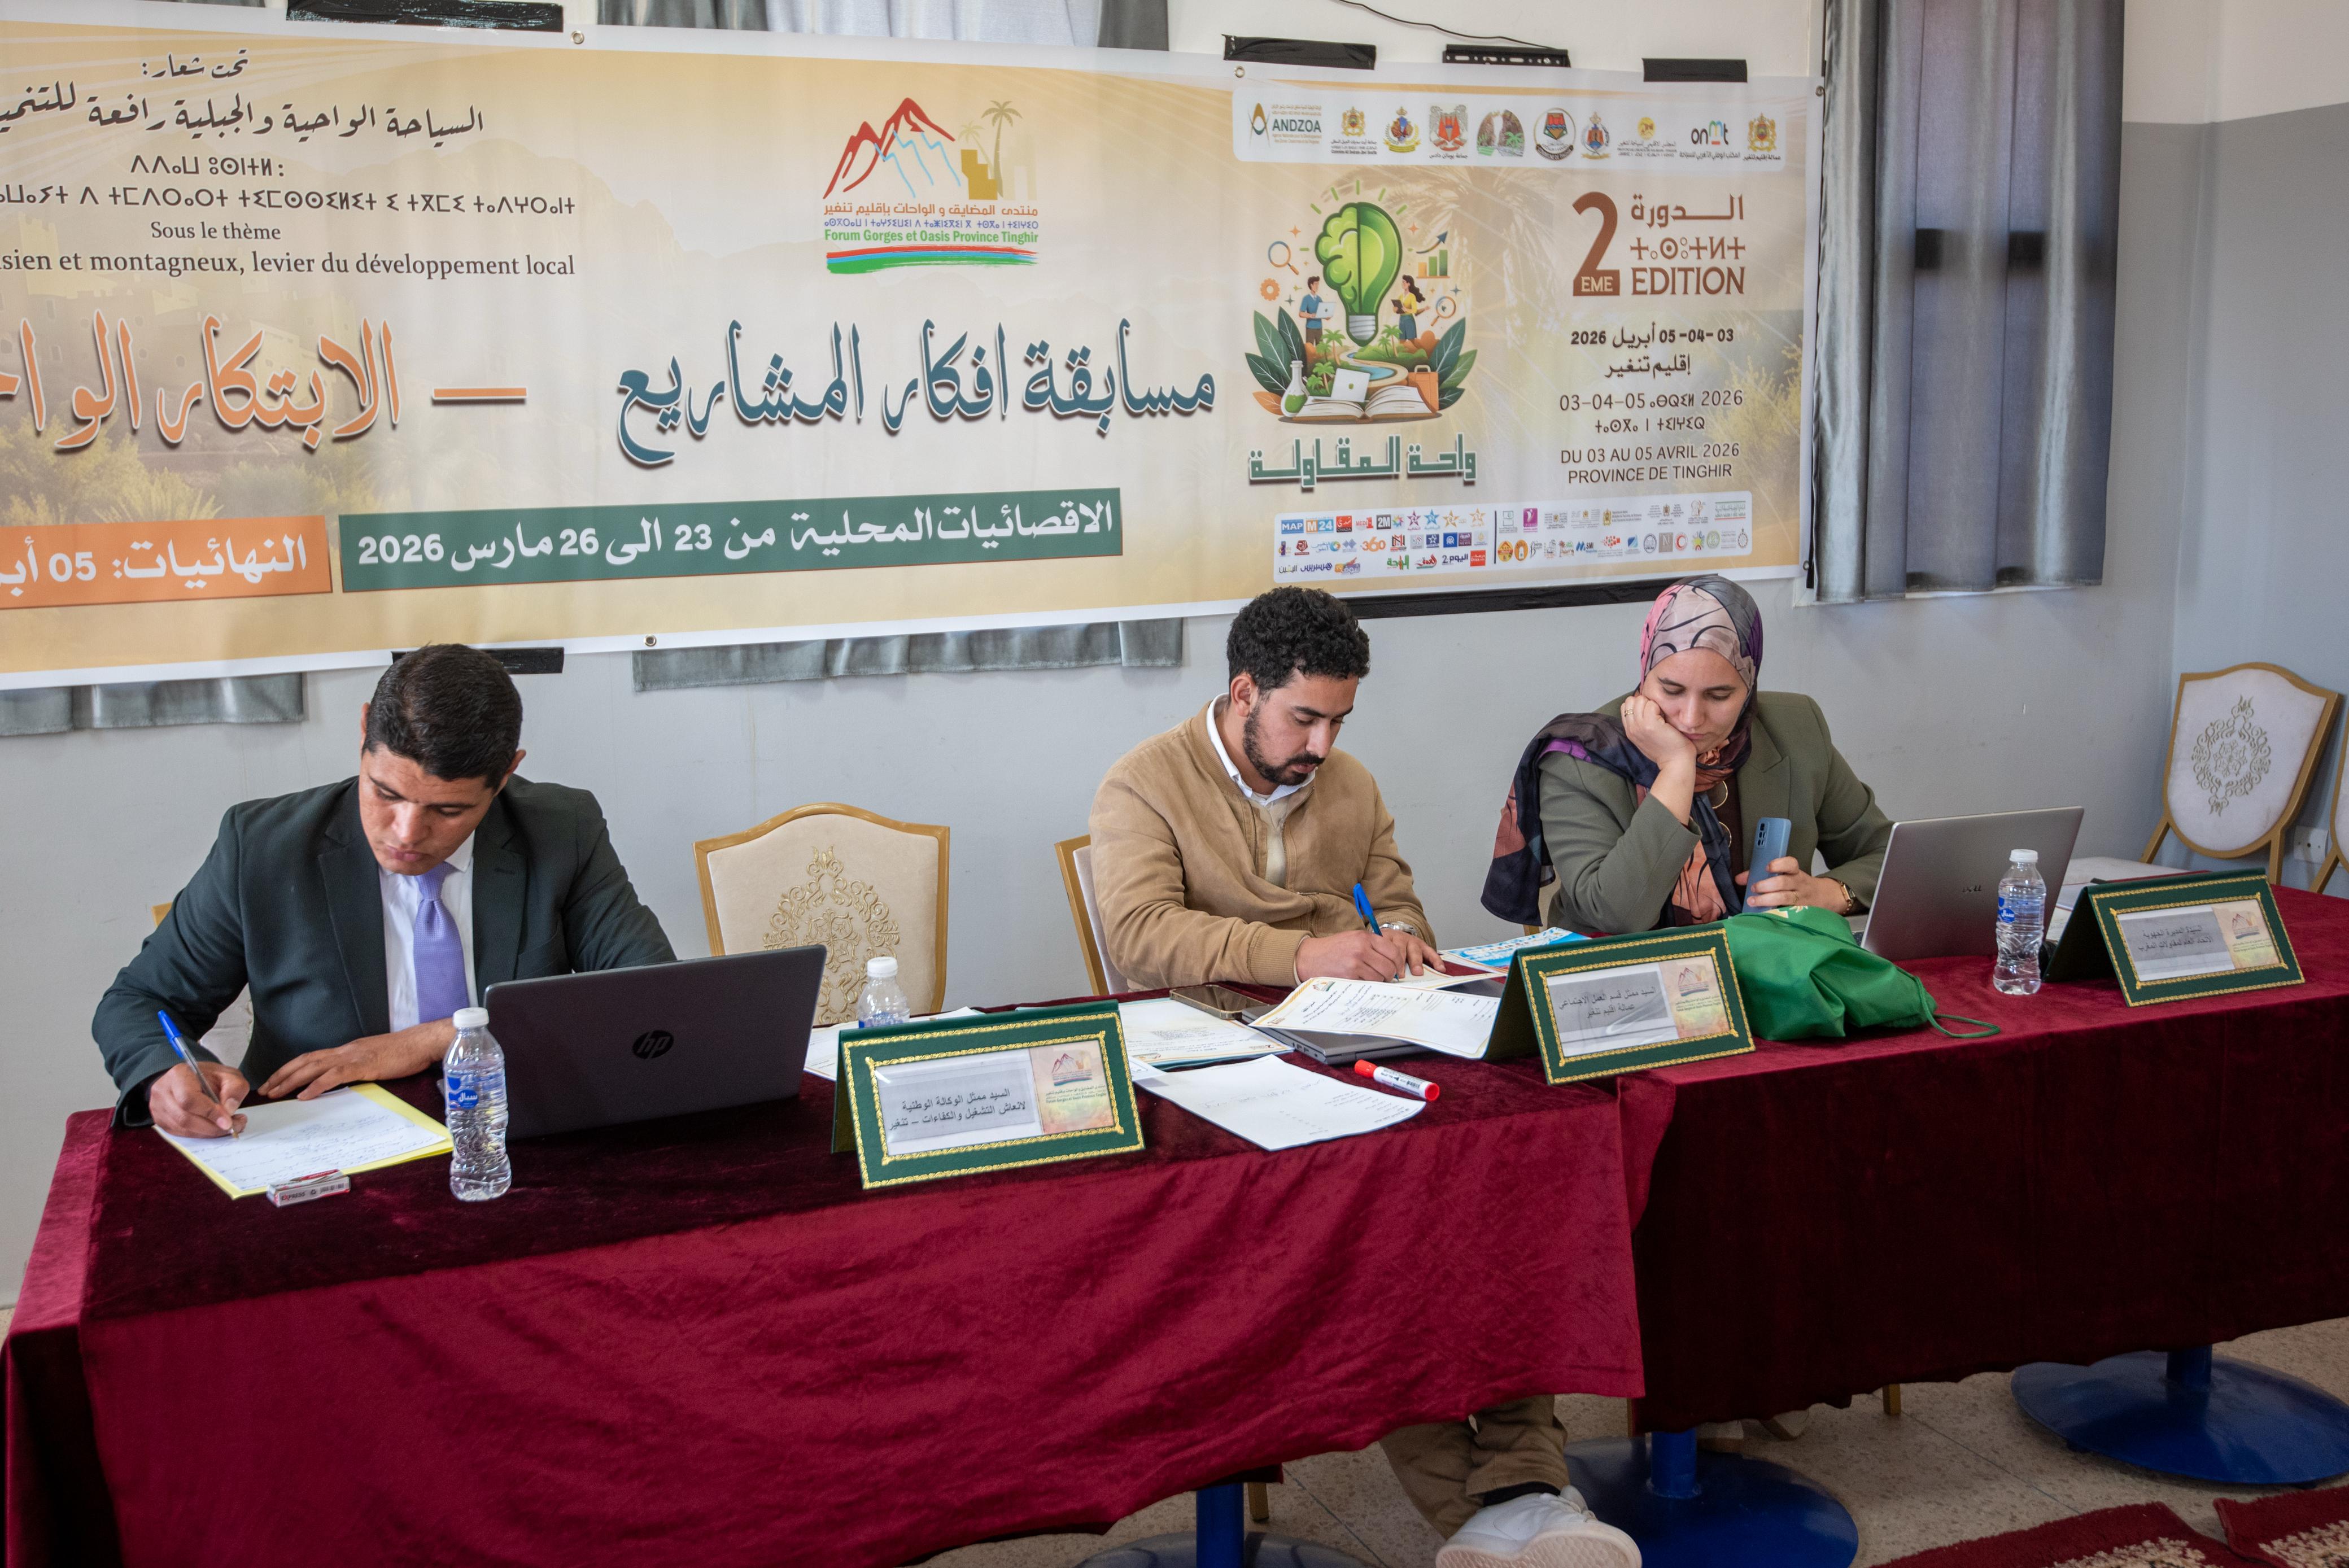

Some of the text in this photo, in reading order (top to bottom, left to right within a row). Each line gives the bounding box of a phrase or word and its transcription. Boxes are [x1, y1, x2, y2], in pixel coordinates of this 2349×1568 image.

[211, 49, 249, 78] تحت
[0, 80, 77, 133] للتنمي
[86, 93, 167, 131] رافعة
[282, 103, 377, 143] الواحية
[386, 103, 484, 148] السياحة
[1272, 119, 1321, 133] ANDZOA
[824, 202, 1038, 217] منتدى المضايق و الواحات بإقليم تنغير
[151, 221, 281, 240] Sous le thème
[824, 229, 1039, 245] Forum Gorges et Oasis Province Tinghir
[1572, 191, 1621, 296] 2
[0, 248, 575, 280] sien et montagneux, levier du développement local
[1580, 276, 1613, 292] EME
[1630, 266, 1747, 295] EDITION
[1570, 330, 1606, 346] 2026
[1612, 321, 1656, 349] أبريل
[1604, 353, 1691, 379] إقليم تنغير
[0, 309, 1217, 466] مسابقة افكار المشاريع الابتكار الوا
[1701, 390, 1744, 407] 2026
[1249, 432, 1477, 488] واحة المقاولة
[1561, 443, 1740, 464] DU 03 AU 05 AVRIL 2026
[1568, 464, 1732, 484] PROVINCE DE TINGHIR
[358, 499, 1114, 572] الاقصائيات المحلية من 23 الى 26 مارس 2026
[1378, 517, 1391, 528] 2M
[0, 535, 39, 597] أب
[49, 551, 97, 583] 05
[636, 1030, 671, 1059] hp
[902, 1088, 1010, 1112] السيد ممثل الوكالة الوطنية
[965, 1104, 996, 1120] التشغيل
[889, 1117, 909, 1131] تنغير
[281, 1191, 306, 1202] EXPRESS
